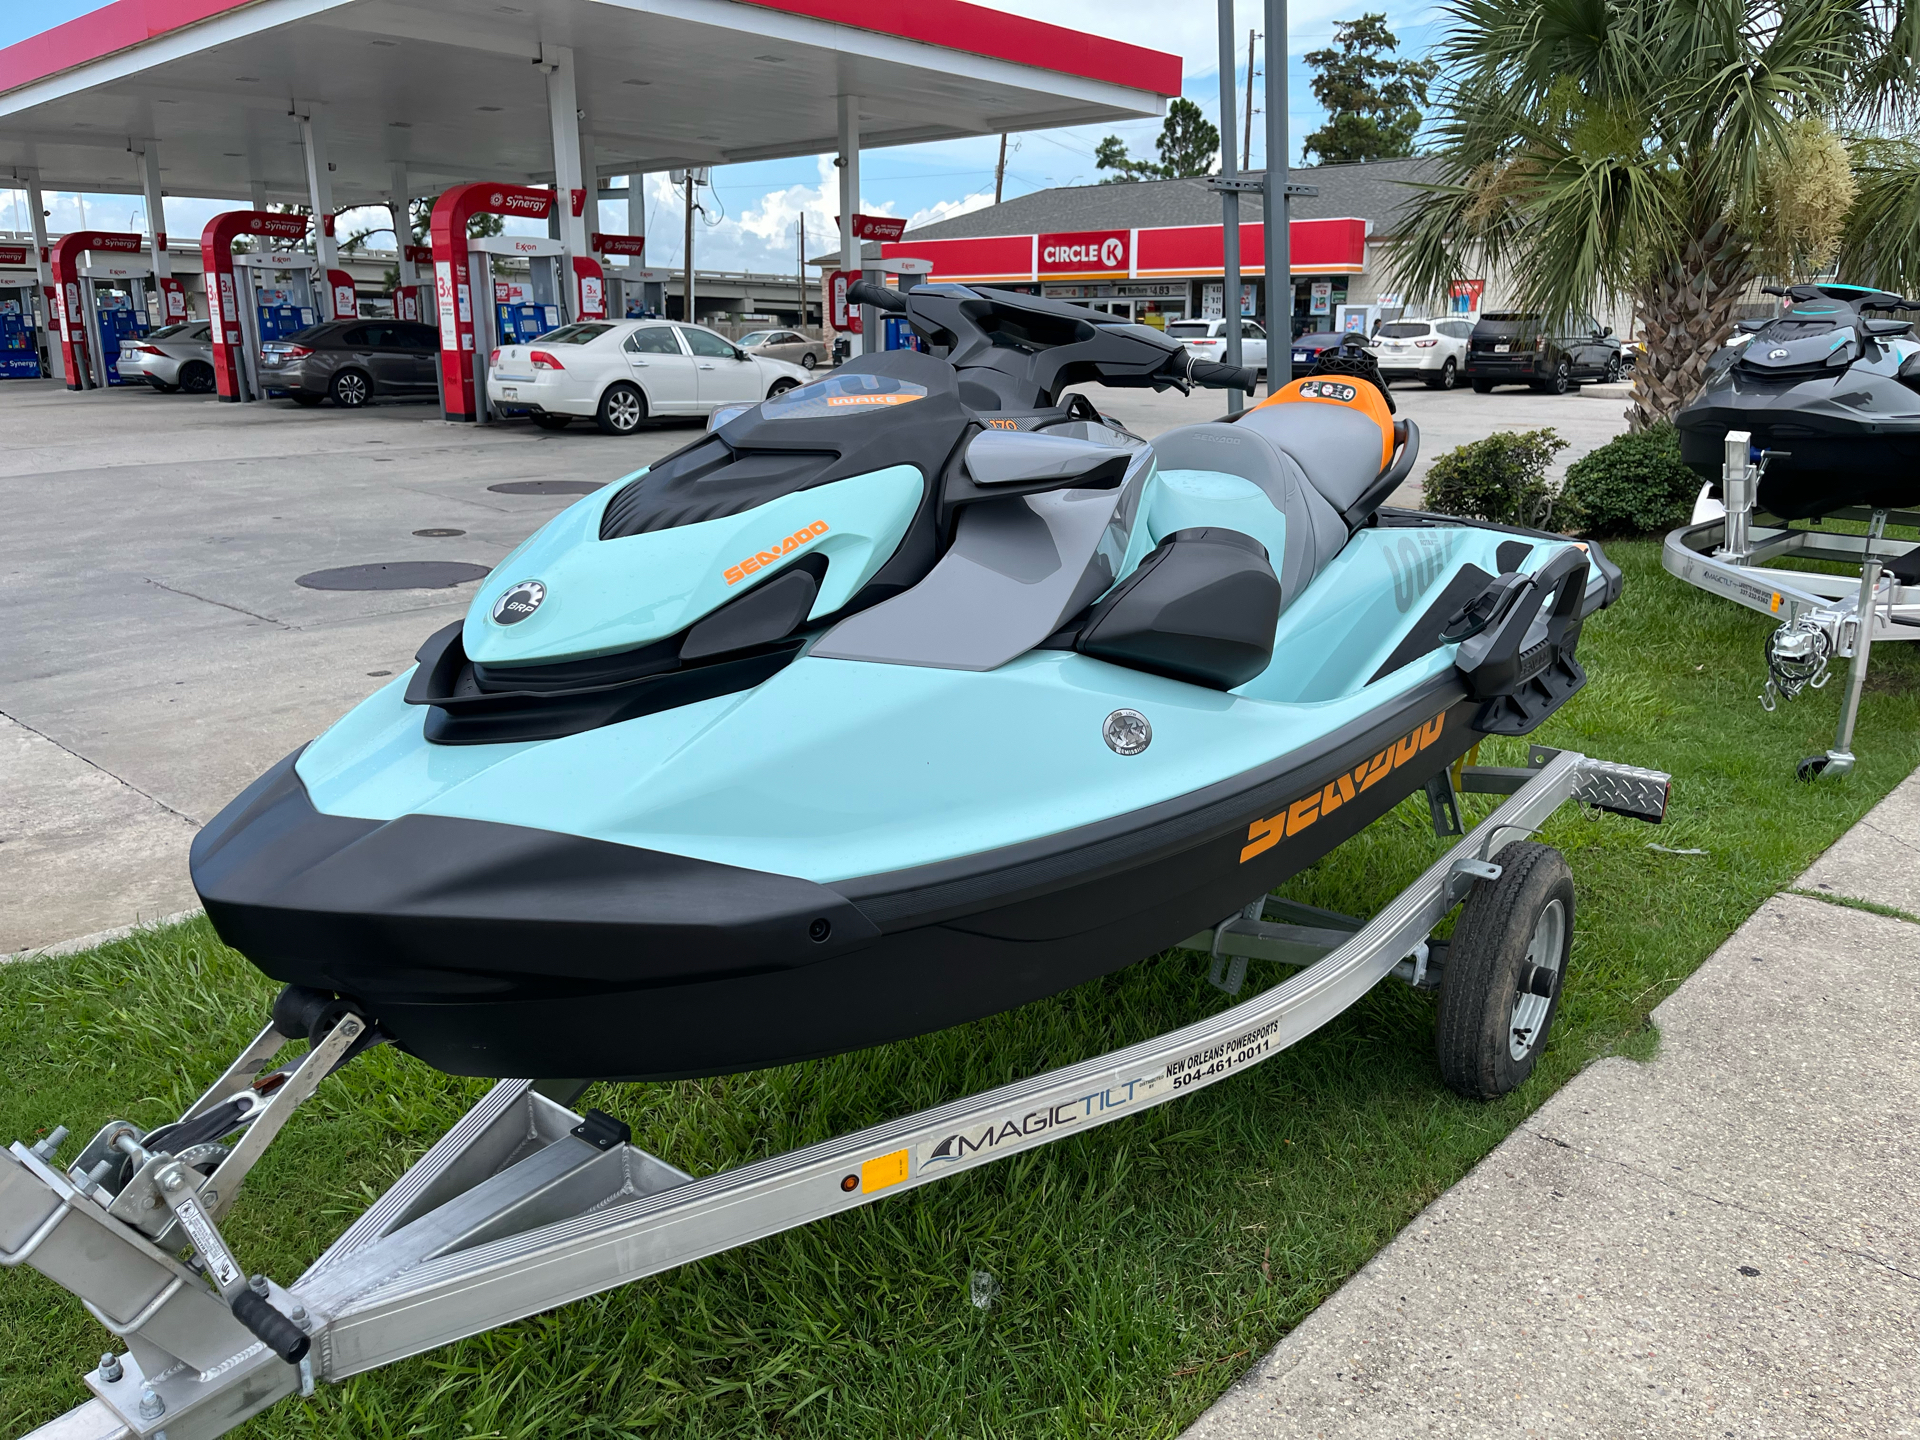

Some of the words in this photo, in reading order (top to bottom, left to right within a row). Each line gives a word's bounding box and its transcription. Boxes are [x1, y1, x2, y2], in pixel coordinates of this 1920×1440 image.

[505, 196, 546, 212] Synergy
[265, 221, 302, 233] Synergy
[874, 225, 901, 237] Synergy
[105, 238, 137, 248] Synergy
[515, 242, 537, 252] Exxon
[614, 241, 640, 251] Synergy
[1043, 244, 1099, 263] CIRCLE
[1105, 242, 1122, 265] K
[272, 256, 291, 264] Exxon
[901, 262, 915, 270] Exxon
[221, 280, 231, 293] 3x
[438, 276, 453, 298] 3x
[586, 284, 597, 295] 3x
[339, 292, 350, 301] 3x
[9, 359, 37, 369] Synergy
[833, 396, 898, 404] WAKE
[989, 420, 1018, 430] 170
[507, 601, 535, 613] BRP
[1139, 1075, 1164, 1088] DISTRIBUTED
[1166, 1060, 1186, 1078] NEW
[1187, 1045, 1225, 1070] ORLEANS
[1226, 1020, 1279, 1055] POWERSPORTS
[1173, 1039, 1270, 1090] 504-461-0011
